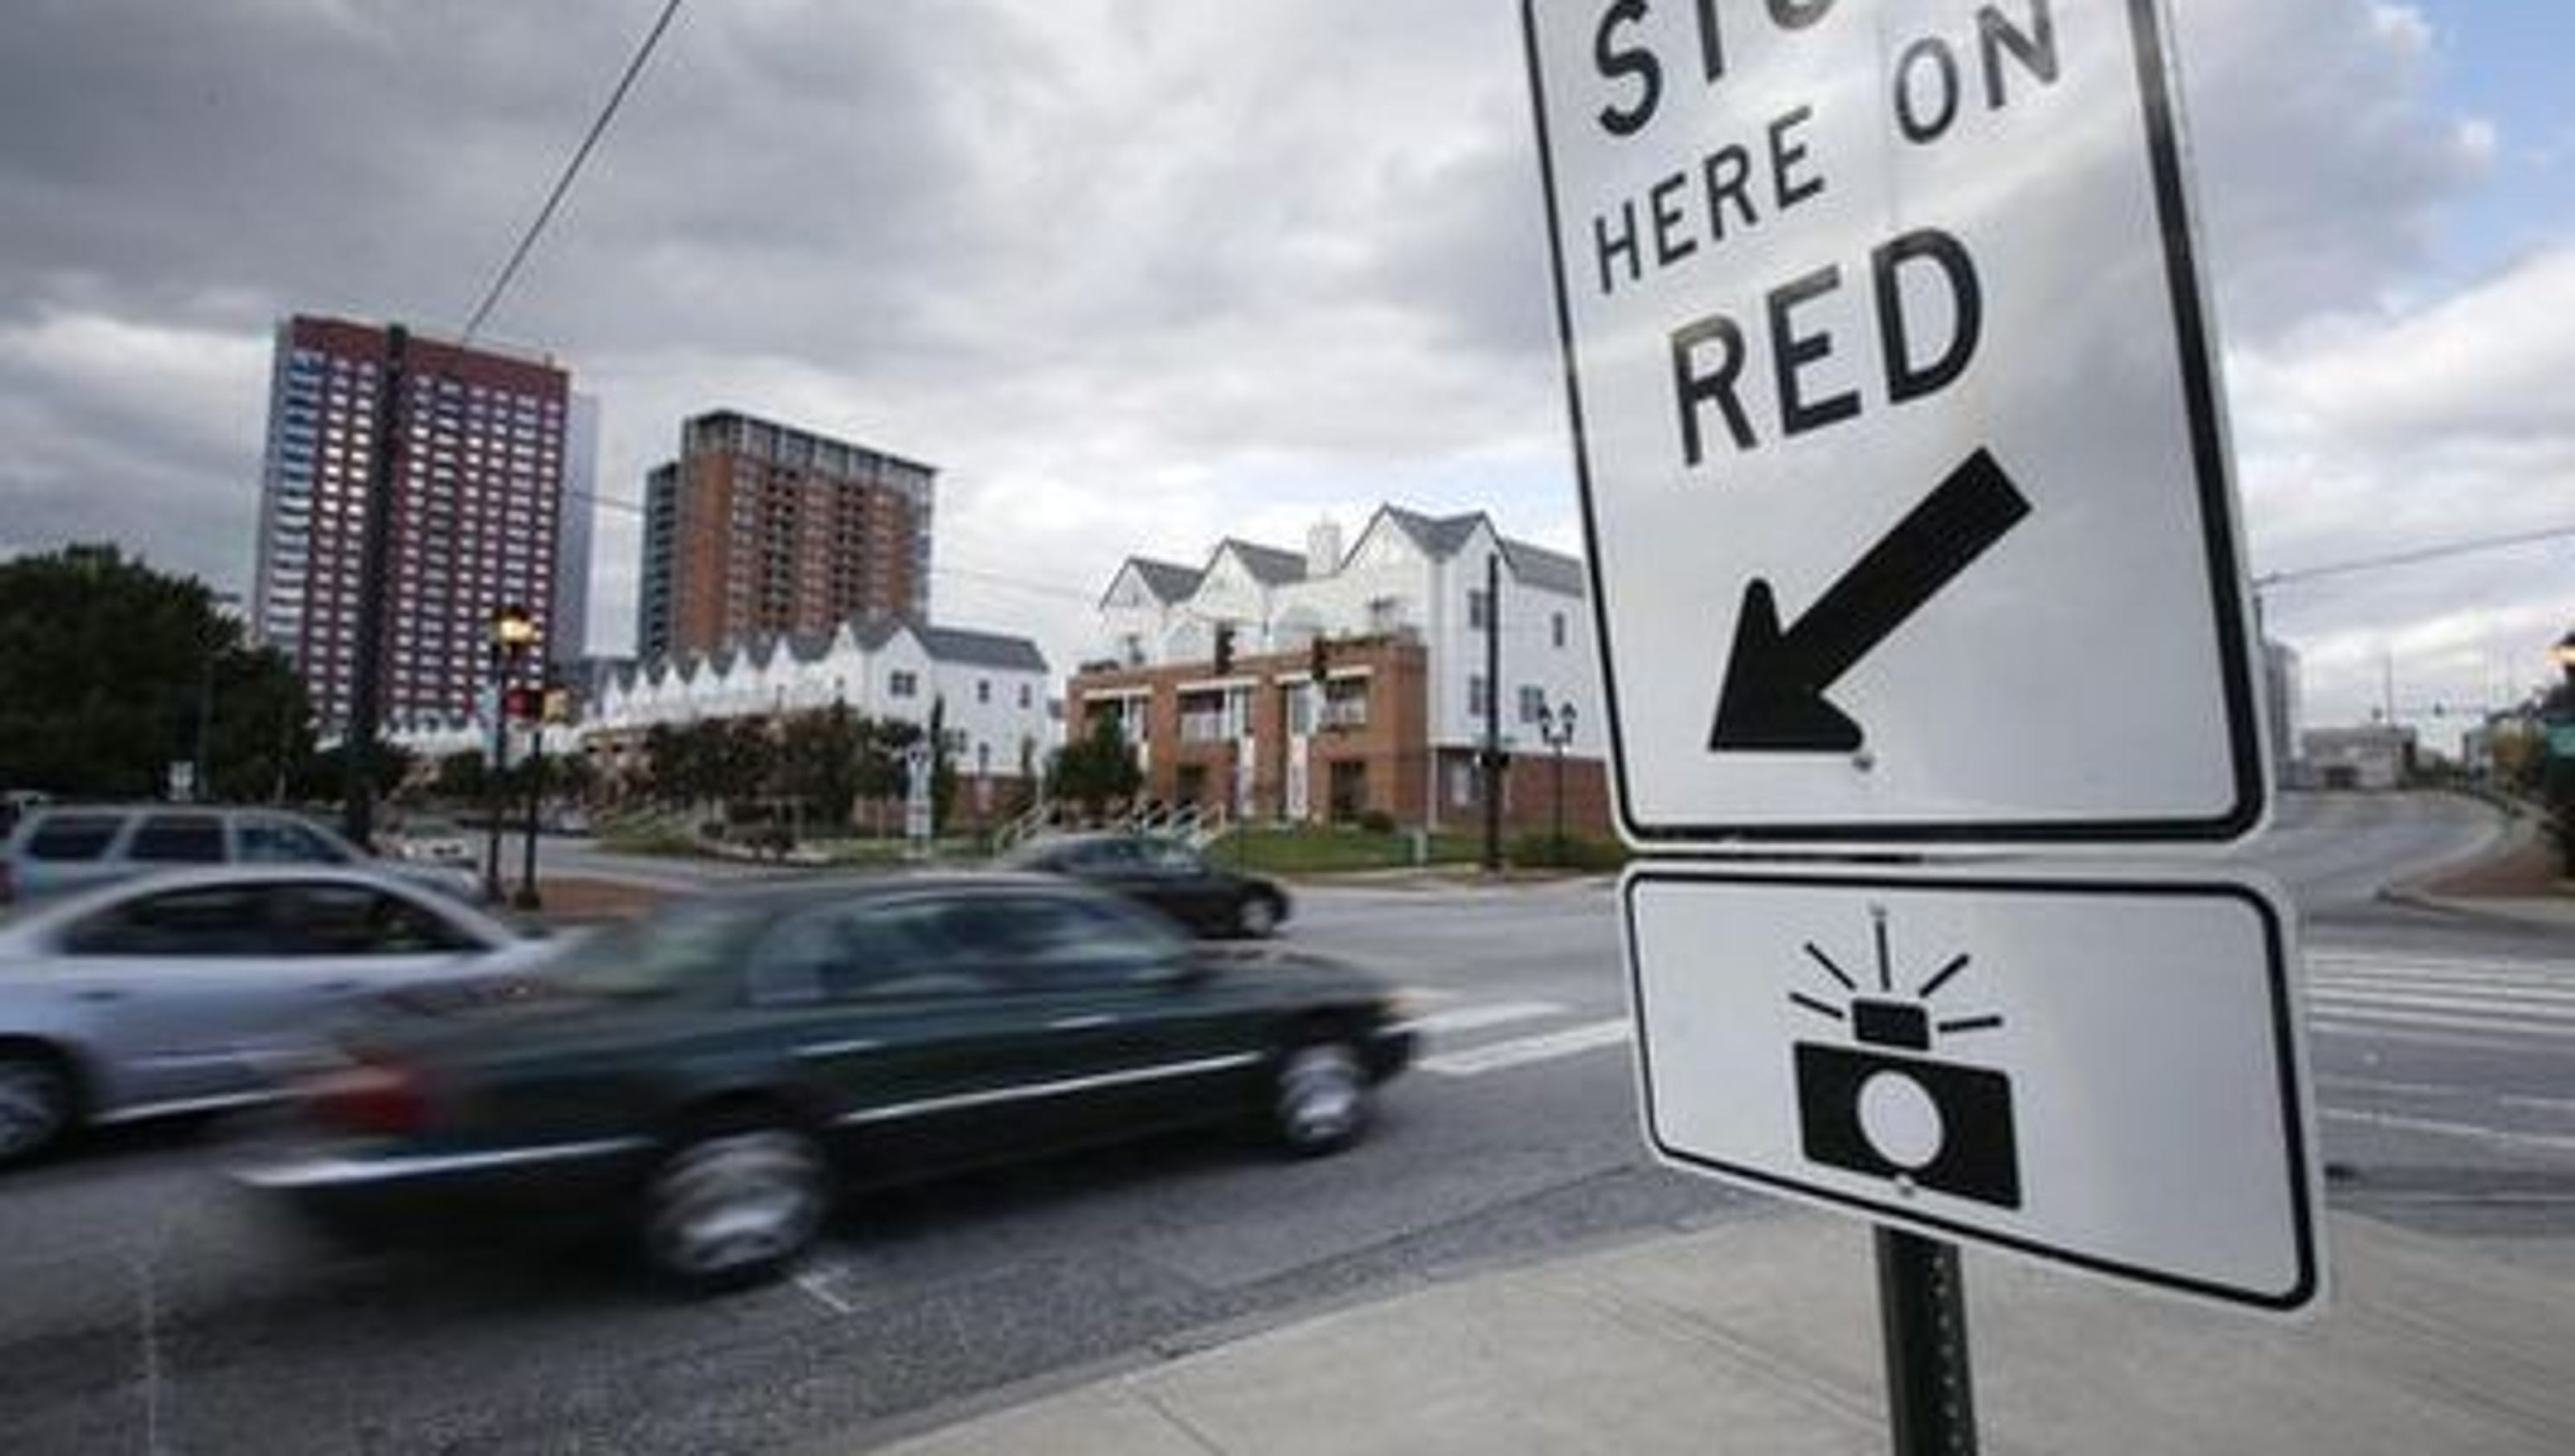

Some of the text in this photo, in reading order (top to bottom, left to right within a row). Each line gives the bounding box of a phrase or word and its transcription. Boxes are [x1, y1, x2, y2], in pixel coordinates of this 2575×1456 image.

[1594, 0, 2058, 296] HERE ON
[1670, 228, 1982, 469] RED
